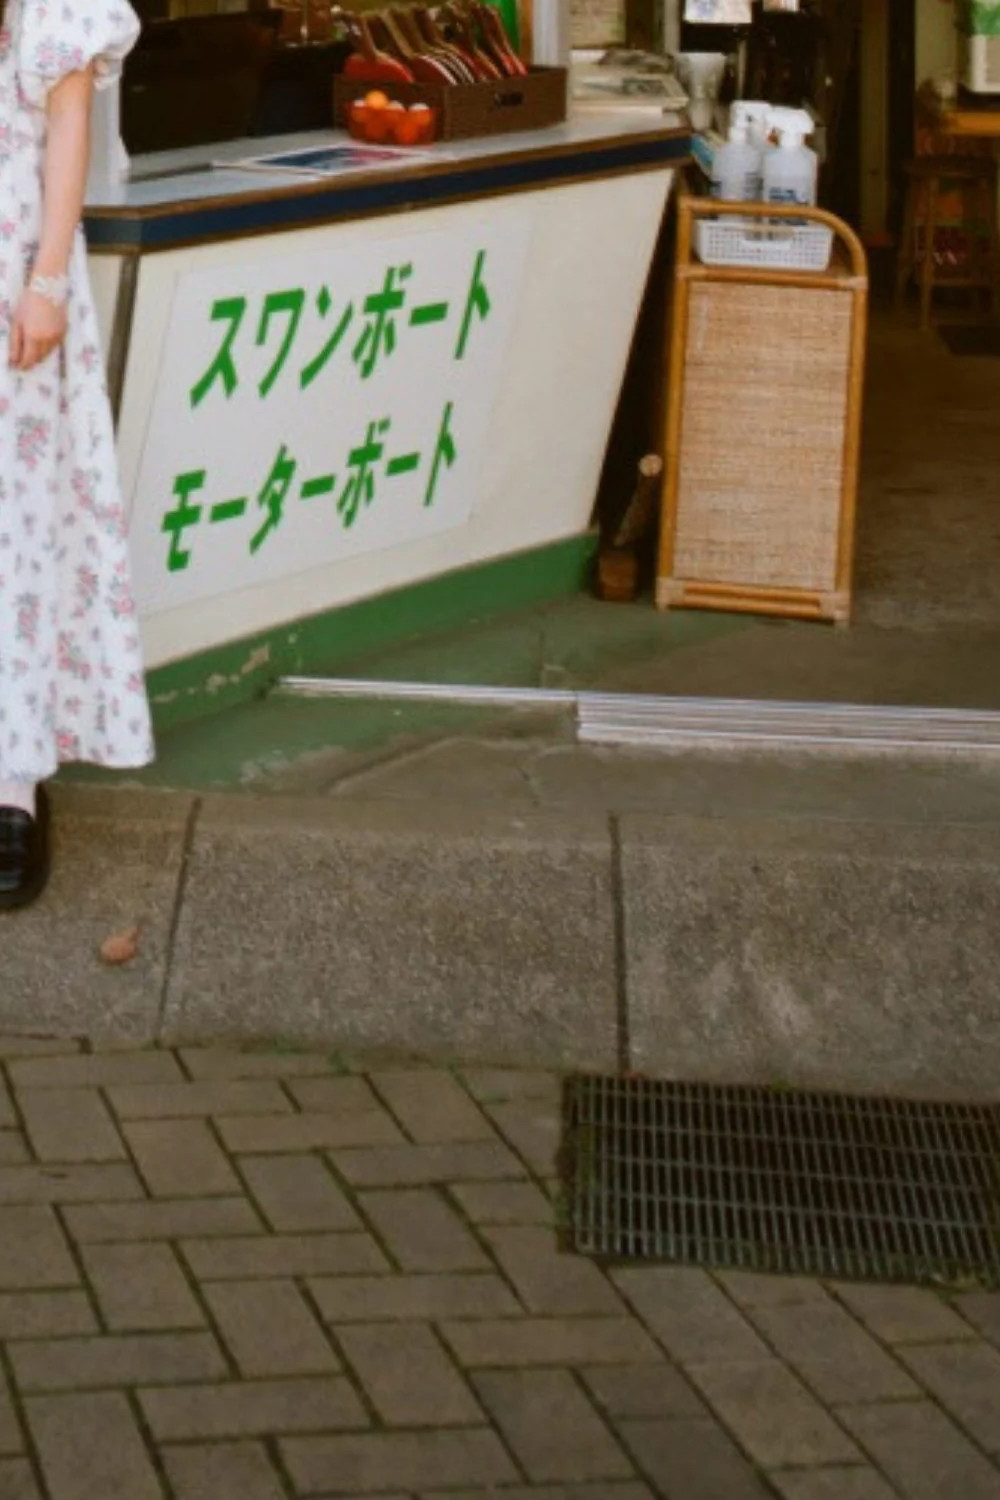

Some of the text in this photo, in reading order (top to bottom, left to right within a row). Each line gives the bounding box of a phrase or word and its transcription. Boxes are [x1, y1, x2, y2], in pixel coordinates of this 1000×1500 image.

[190, 249, 491, 409] スワンボート
[161, 401, 457, 572] モーターボート
